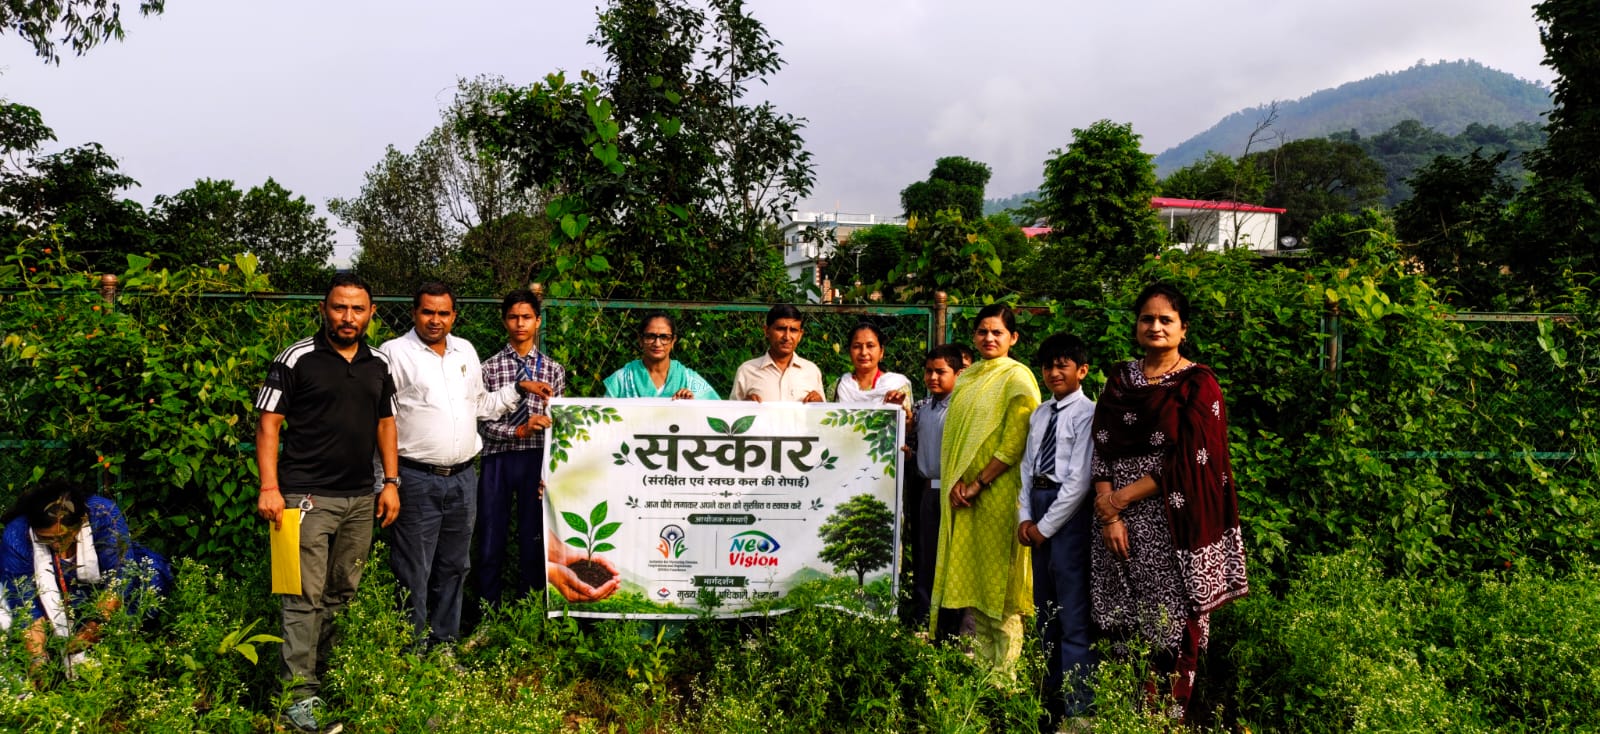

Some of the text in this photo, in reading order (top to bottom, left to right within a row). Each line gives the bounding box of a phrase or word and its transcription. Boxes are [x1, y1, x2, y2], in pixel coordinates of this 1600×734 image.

[633, 424, 819, 473] संस्कार
[690, 475, 704, 487] एवं
[708, 477, 735, 487] स्वच्छ
[738, 477, 758, 487] कल
[761, 475, 775, 487] की
[778, 475, 810, 488] रोपाई)
[644, 501, 659, 509] आज
[673, 501, 698, 509] लगाकर
[717, 501, 731, 509] कल
[732, 500, 742, 509] को
[729, 552, 778, 568] Vision
[703, 577, 734, 586] मार्गदर्शन
[677, 590, 696, 600] मुख्य
